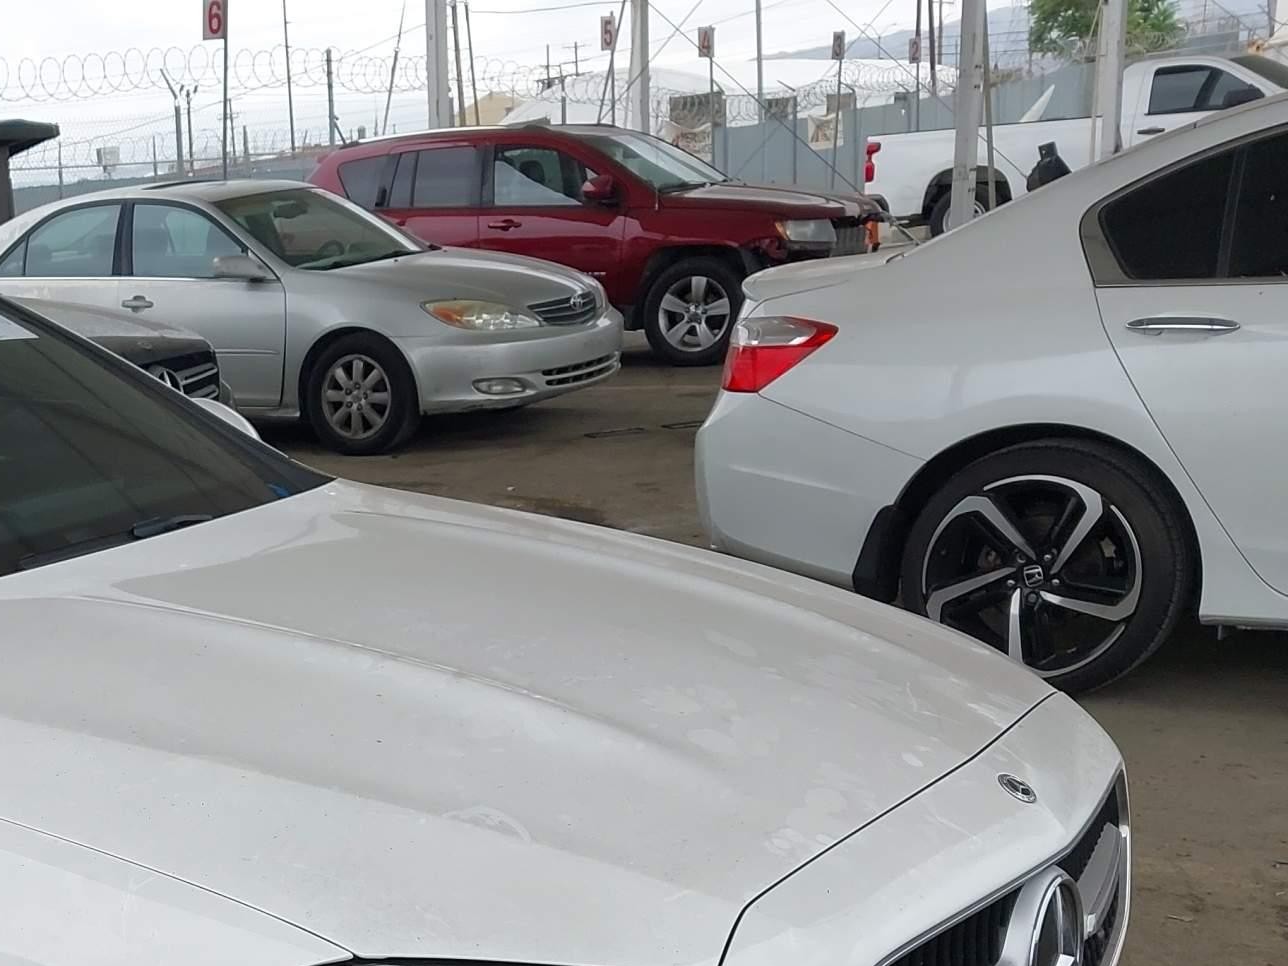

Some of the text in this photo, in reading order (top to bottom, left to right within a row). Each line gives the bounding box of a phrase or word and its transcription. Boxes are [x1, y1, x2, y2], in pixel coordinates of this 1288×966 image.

[208, 0, 222, 34] 6
[604, 19, 613, 46] 5
[702, 30, 711, 54] 4
[834, 35, 842, 56] 3
[911, 41, 919, 60] 2
